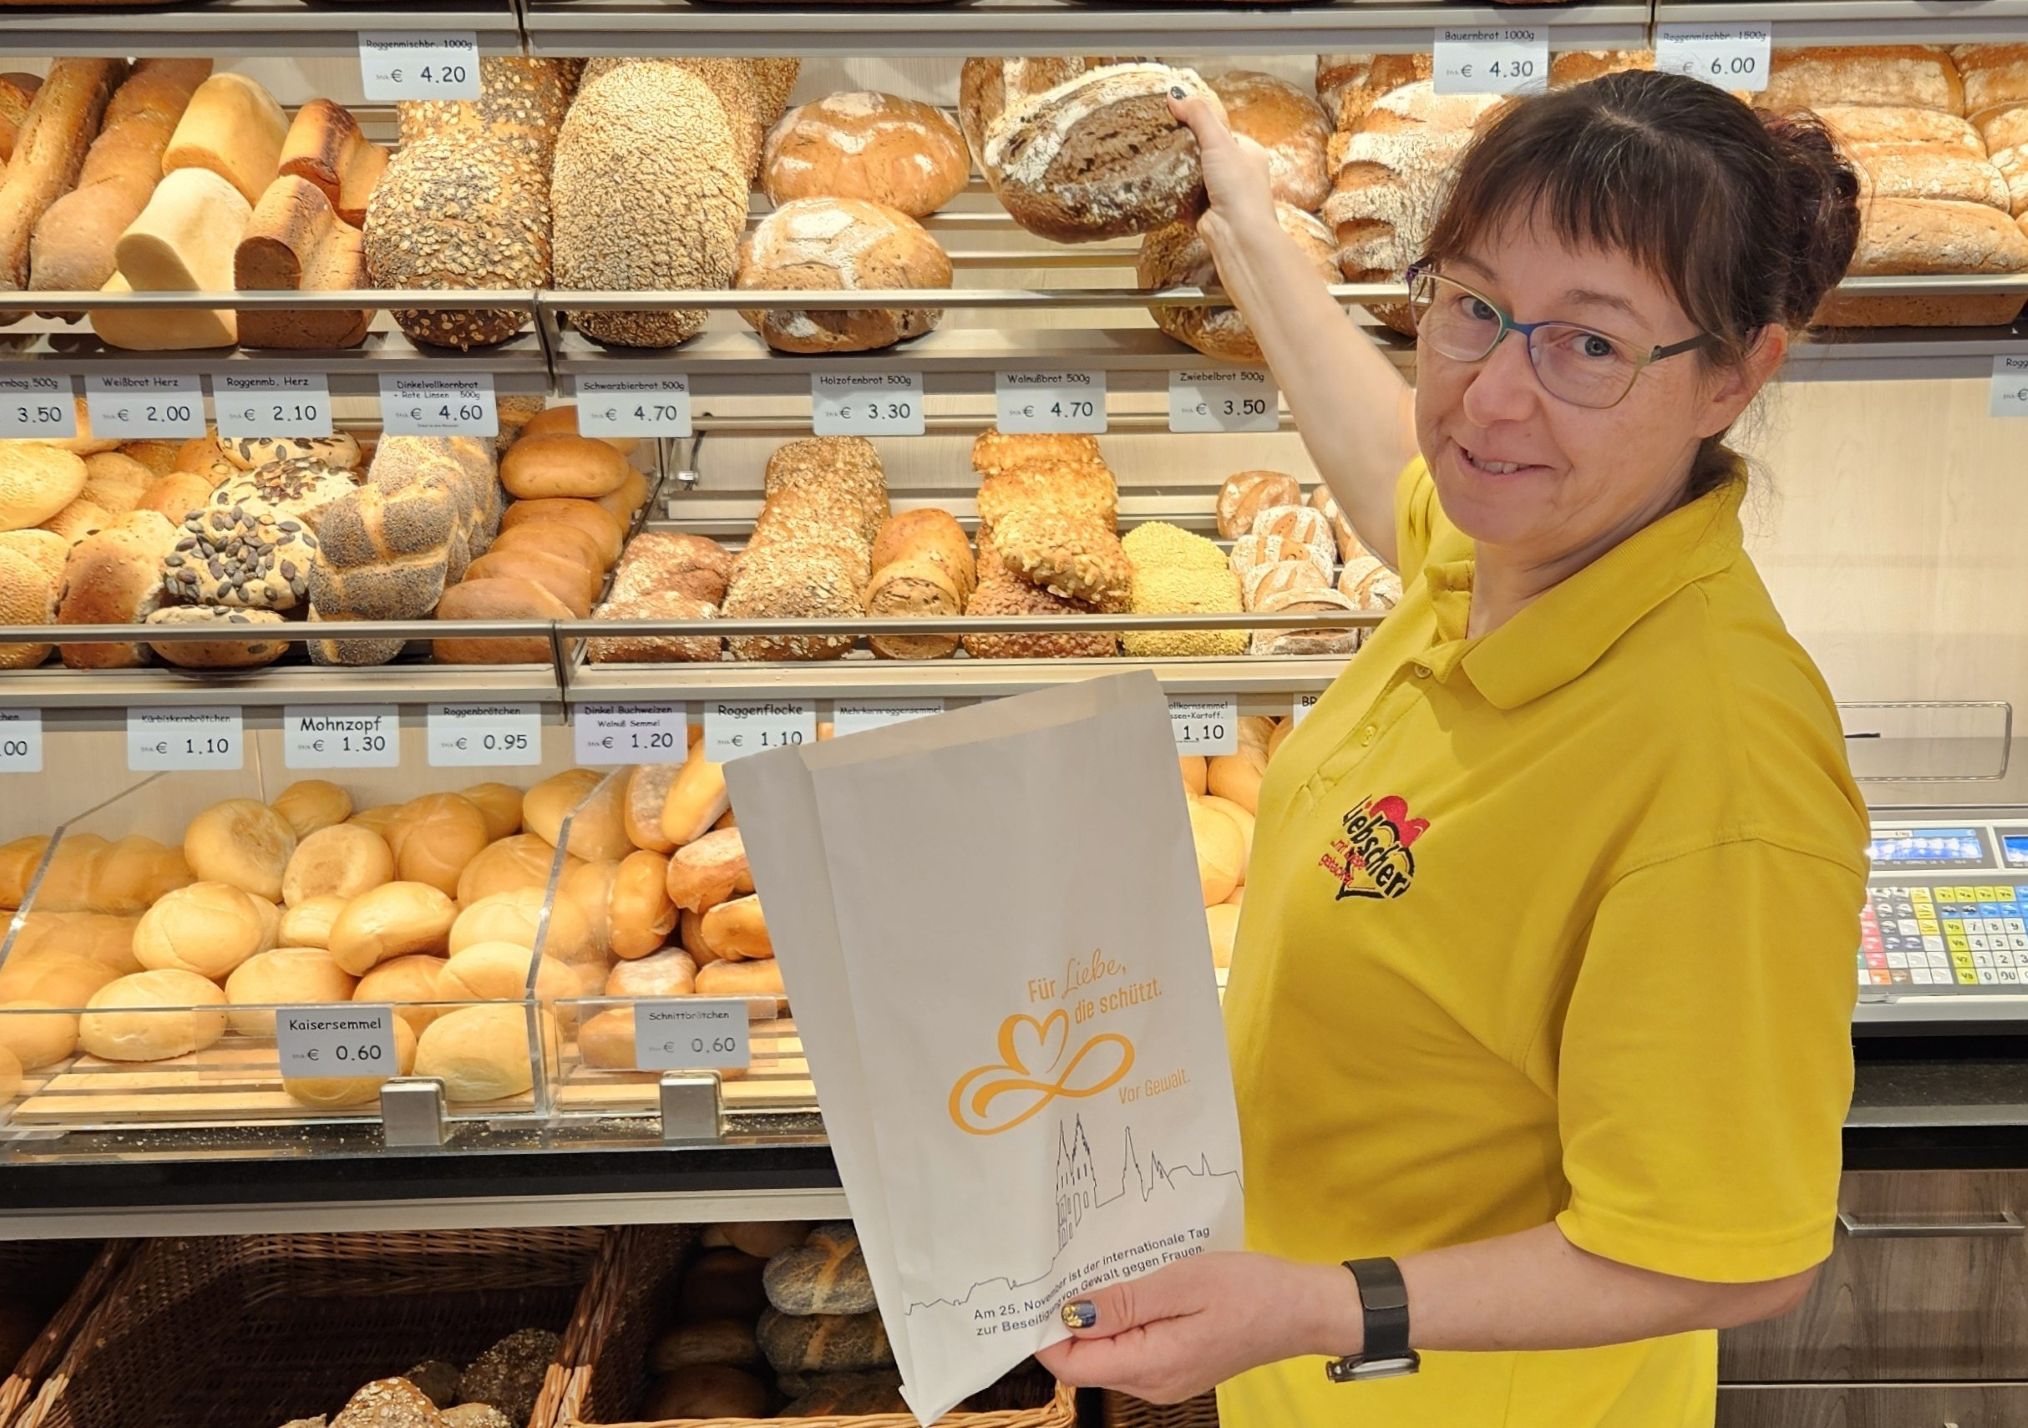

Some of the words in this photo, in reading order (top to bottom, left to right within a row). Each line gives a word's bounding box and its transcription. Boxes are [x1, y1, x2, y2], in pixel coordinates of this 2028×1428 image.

[1444, 30, 1499, 40] Bauernbrot
[1504, 30, 1535, 41] 1000g
[443, 39, 473, 50] 1000g
[391, 69, 403, 82] €
[420, 66, 466, 83] 4.20
[1461, 64, 1473, 78] €
[1489, 60, 1534, 78] 4.30
[1711, 57, 1755, 75] 6.00
[32, 377, 58, 390] 500g
[102, 377, 151, 387] Weißbrot
[154, 377, 179, 387] Herz
[226, 377, 280, 388] Roggenmb.
[284, 376, 309, 386] Herz
[396, 380, 478, 390] Dinkelvollkornbrot
[820, 375, 883, 385] Holzofenbrot
[887, 375, 912, 387] 500g
[1007, 373, 1063, 384] Walnußbrot
[1066, 373, 1091, 385] 500g
[1179, 372, 1236, 382] Zwiebelbrot
[1240, 371, 1265, 383] 500g
[583, 380, 659, 390] Schwarzbierbrot
[662, 381, 685, 392] 500g
[17, 406, 62, 423] 3.50
[118, 409, 129, 422] €
[146, 405, 191, 422] 2.00
[244, 408, 256, 422] €
[273, 405, 317, 422] 2.10
[410, 407, 422, 421] €
[439, 404, 483, 421] 4.60
[605, 408, 617, 422] €
[633, 405, 678, 422] 4.70
[840, 406, 852, 419] €
[868, 403, 911, 420] 3.30
[1023, 405, 1035, 418] €
[1050, 401, 1093, 418] 4.70
[1196, 402, 1208, 415] €
[1223, 399, 1266, 416] 3.50
[443, 706, 521, 718] Roggenbrötchen
[584, 705, 614, 715] Dinkel
[618, 705, 673, 715] Buchweizen
[718, 703, 803, 719] Roggenflocke
[300, 716, 383, 735] Mohnzopf
[1183, 724, 1225, 741] 1.10
[156, 741, 168, 754] €
[186, 738, 229, 755] 1.10
[313, 739, 325, 752] €
[343, 735, 386, 752] 1.30
[456, 737, 468, 750] €
[483, 734, 528, 750] 0.95
[602, 736, 614, 749] €
[631, 732, 674, 749] 1.20
[732, 735, 743, 748] €
[760, 730, 803, 748] 1.10
[1027, 977, 1056, 1003] Für
[1061, 947, 1127, 1000] Liebe,
[1074, 999, 1095, 1025] die
[1099, 977, 1163, 1014] schützt.
[289, 1017, 381, 1031] Kaisersemmel
[648, 1011, 730, 1021] Schnittbrtchen
[307, 1048, 319, 1061] €
[335, 1044, 382, 1061] 0.60
[691, 1036, 736, 1053] 0.60
[1118, 1085, 1141, 1105] Vor
[1144, 1067, 1192, 1098] Gewalt.
[973, 1308, 996, 1321] Am
[998, 1302, 1020, 1316] 25.
[1069, 1267, 1082, 1283] ist
[1083, 1259, 1100, 1275] der
[1102, 1233, 1185, 1267] internationale
[1186, 1226, 1211, 1240] Tag
[975, 1324, 998, 1336] zur
[1062, 1286, 1079, 1301] von
[1080, 1267, 1120, 1292] Gewalt
[1121, 1257, 1160, 1278] gegen
[1162, 1244, 1206, 1264] Frauen.
